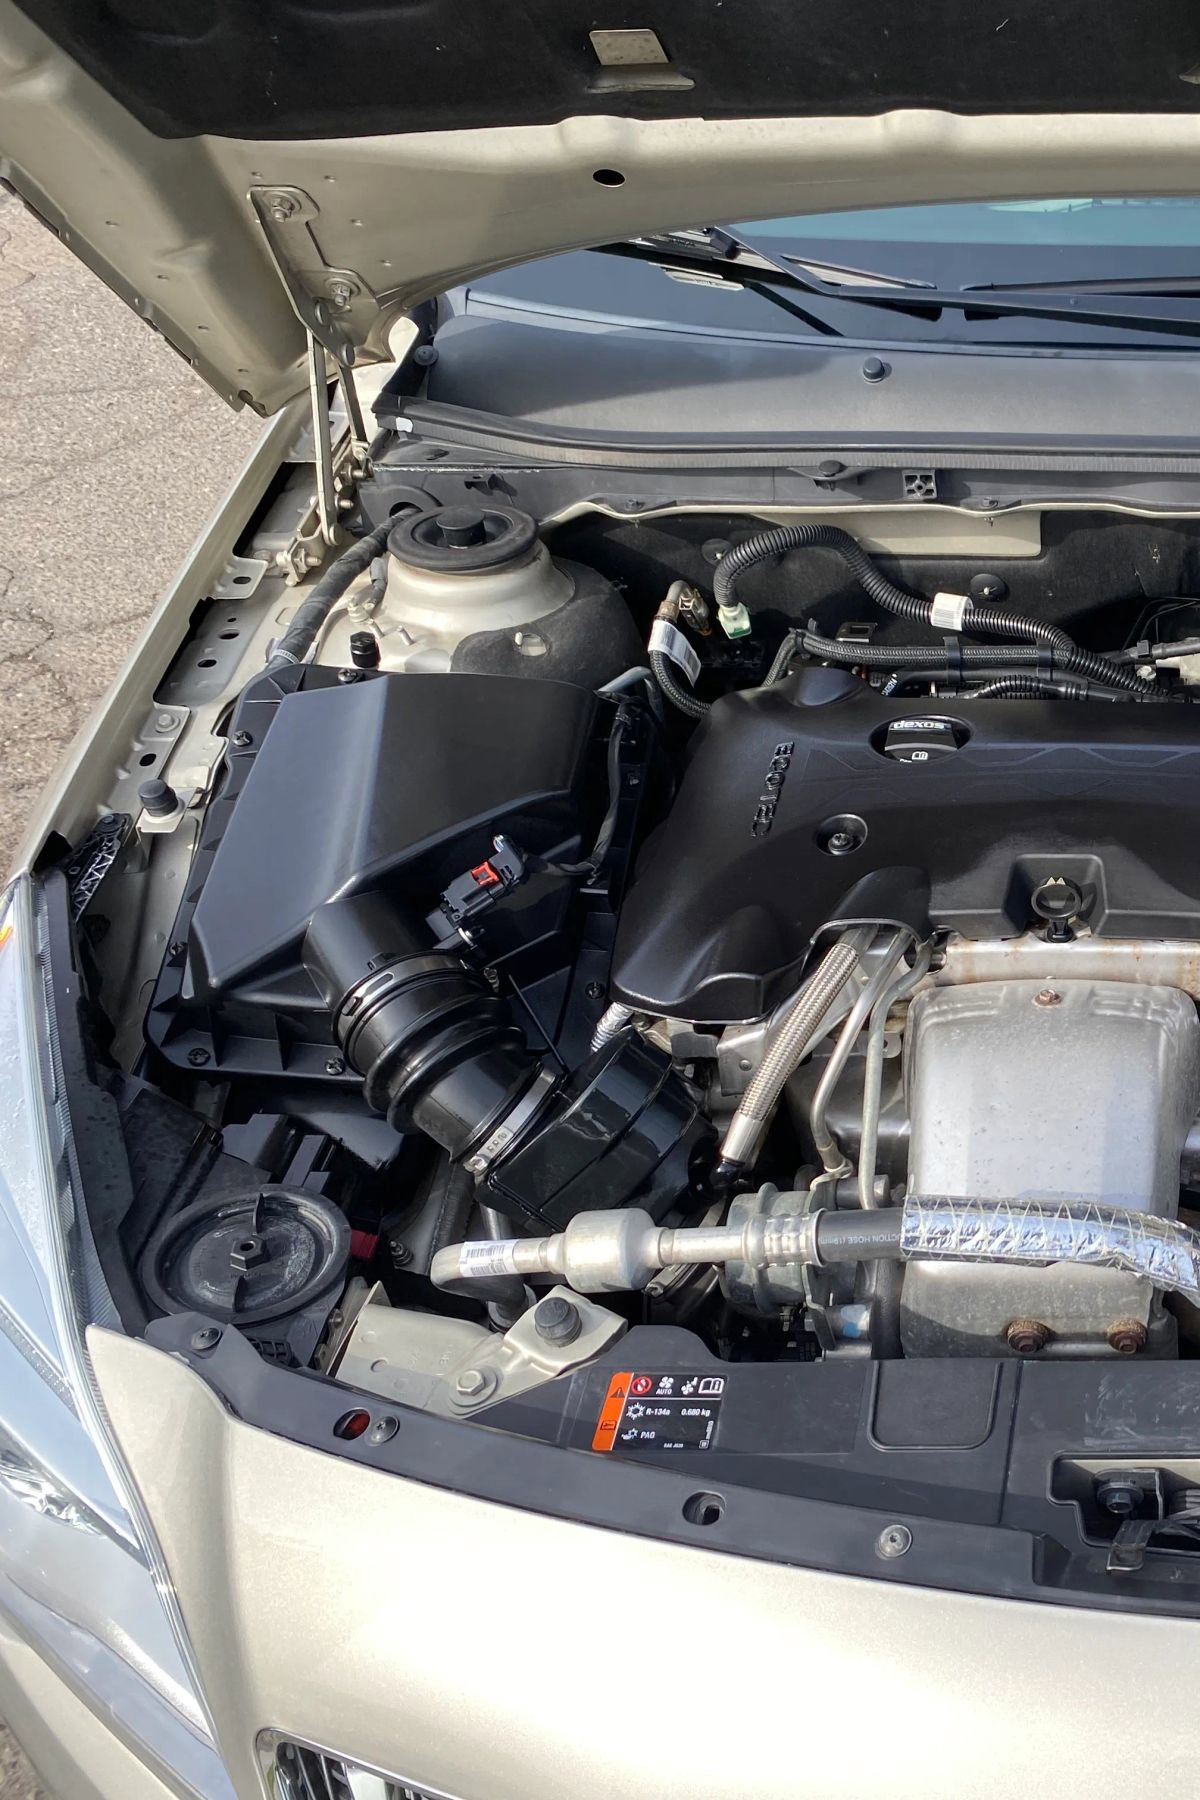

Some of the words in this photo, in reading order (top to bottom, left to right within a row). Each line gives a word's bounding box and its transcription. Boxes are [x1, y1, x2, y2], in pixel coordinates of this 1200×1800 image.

[847, 1235, 871, 1245] HOSE
[646, 1408, 671, 1416] R-134a
[701, 1408, 711, 1417] kg
